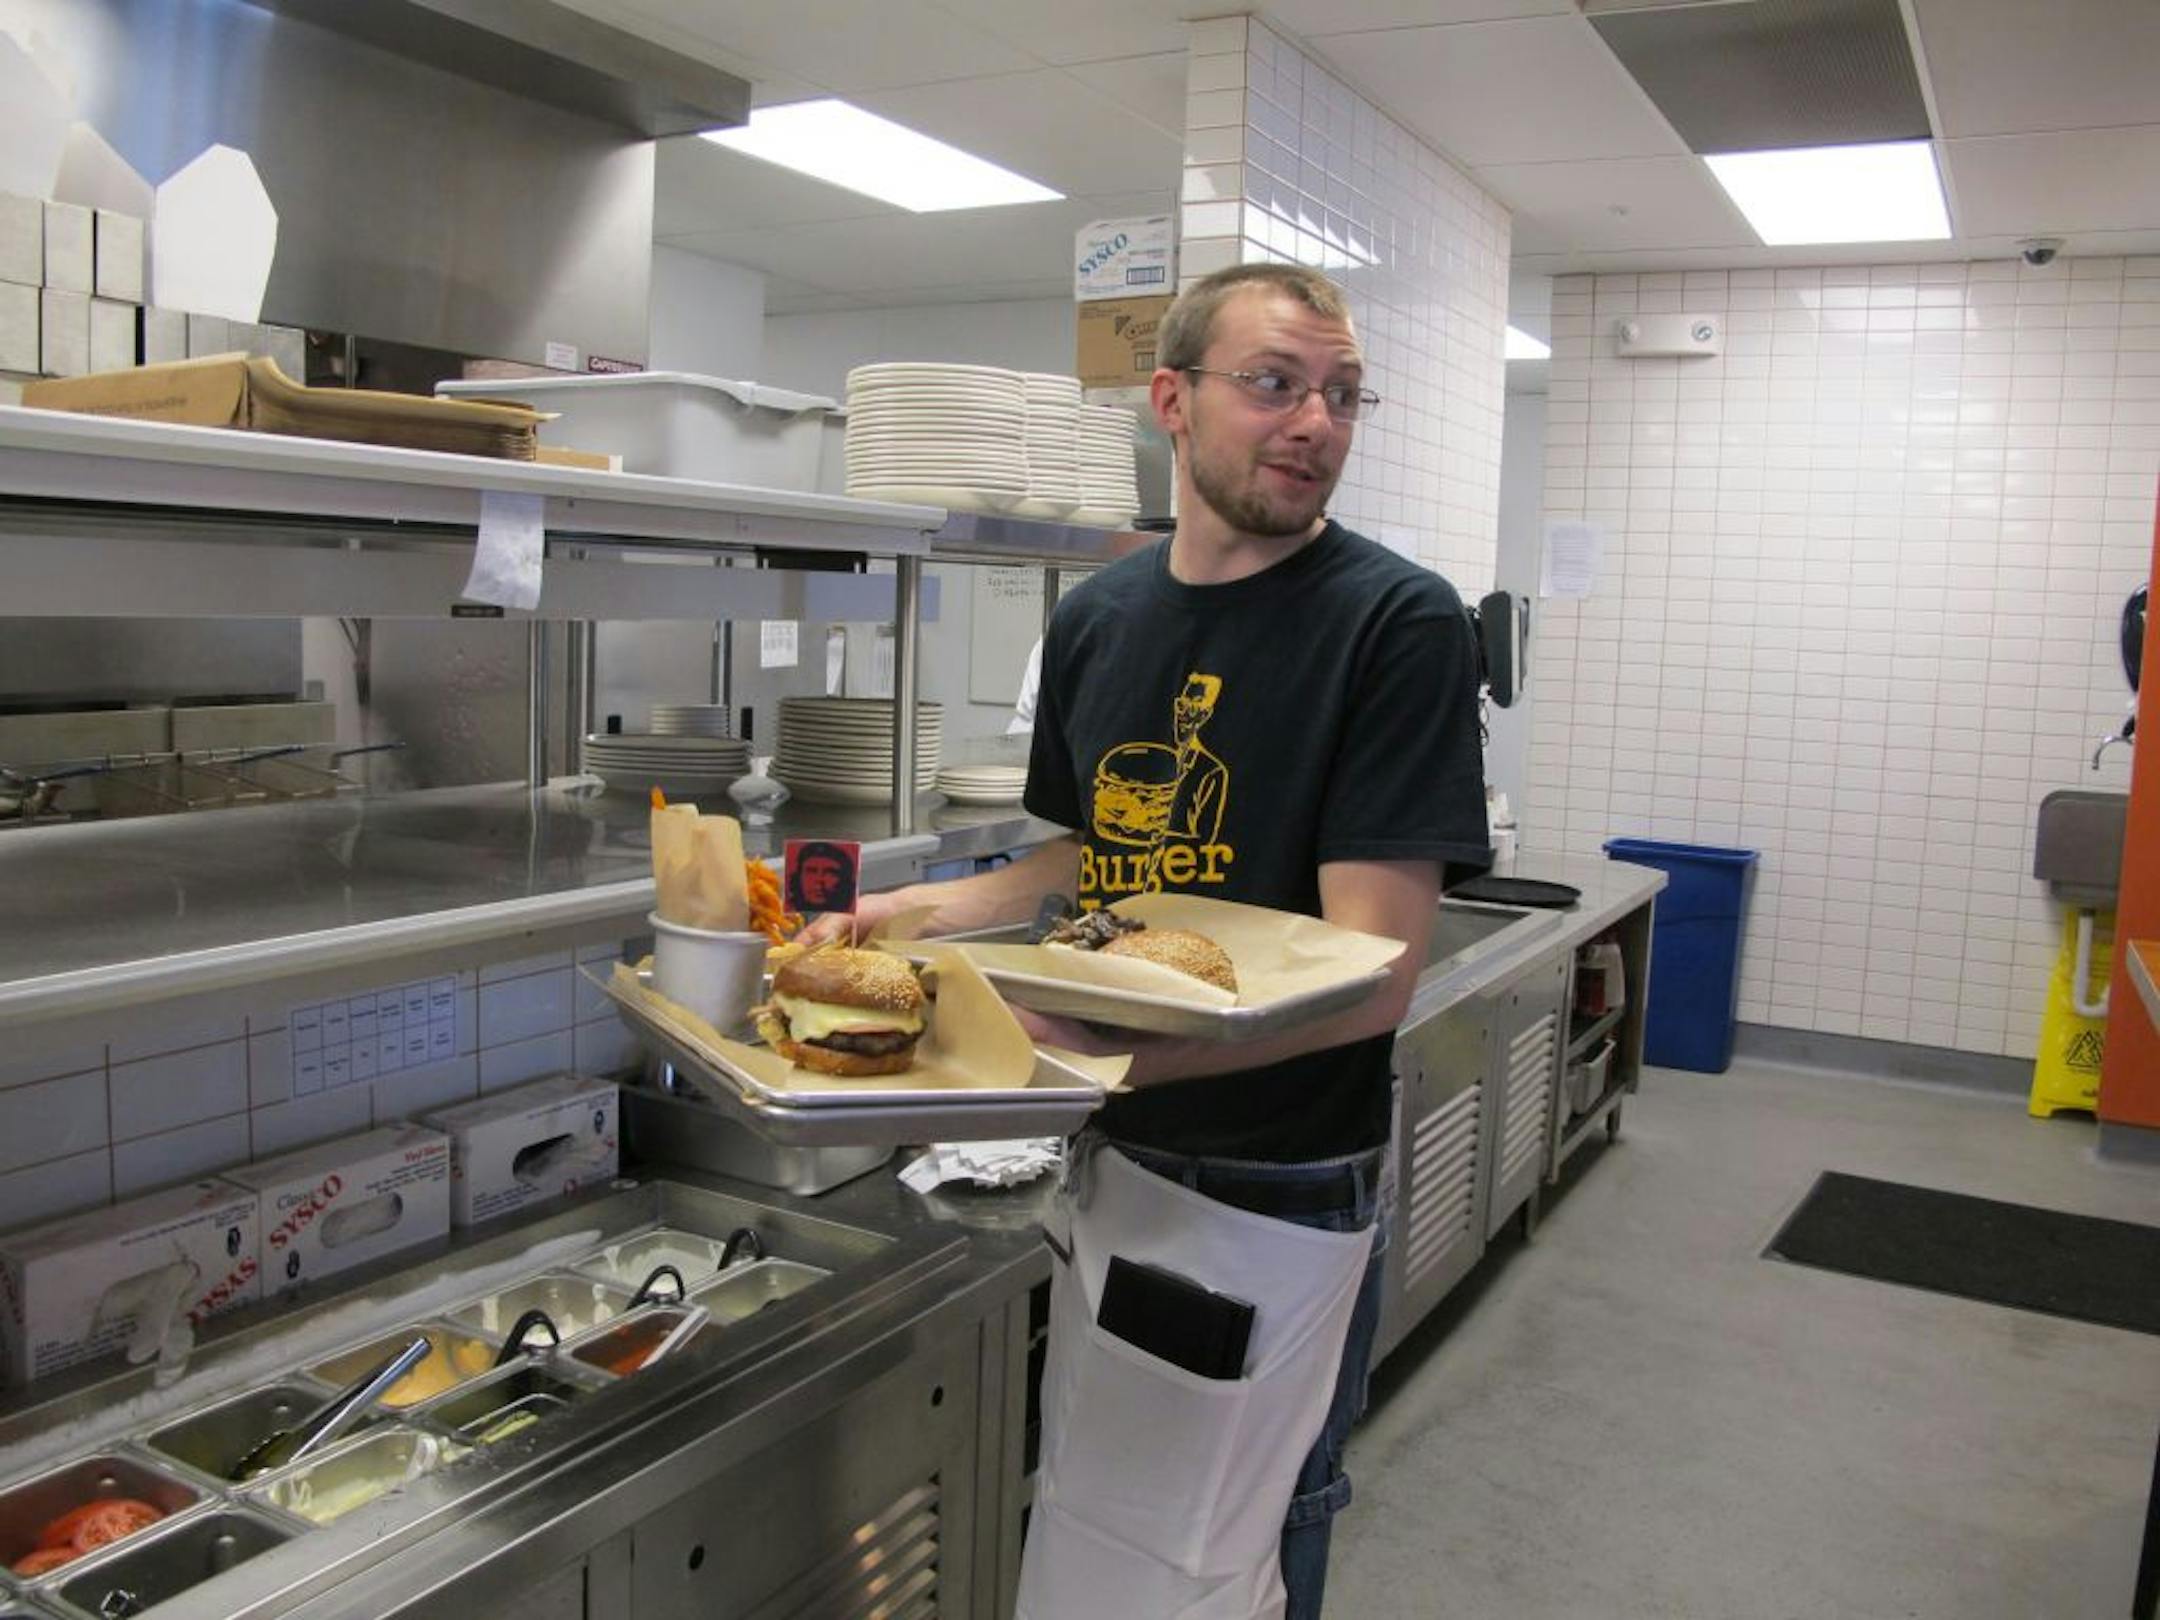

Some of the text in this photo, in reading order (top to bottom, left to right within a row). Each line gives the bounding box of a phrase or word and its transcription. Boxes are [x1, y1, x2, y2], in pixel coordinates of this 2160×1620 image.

[1079, 233, 1128, 273] SYSCO
[1079, 844, 1234, 895] Burger
[269, 1174, 342, 1250] SYSCO
